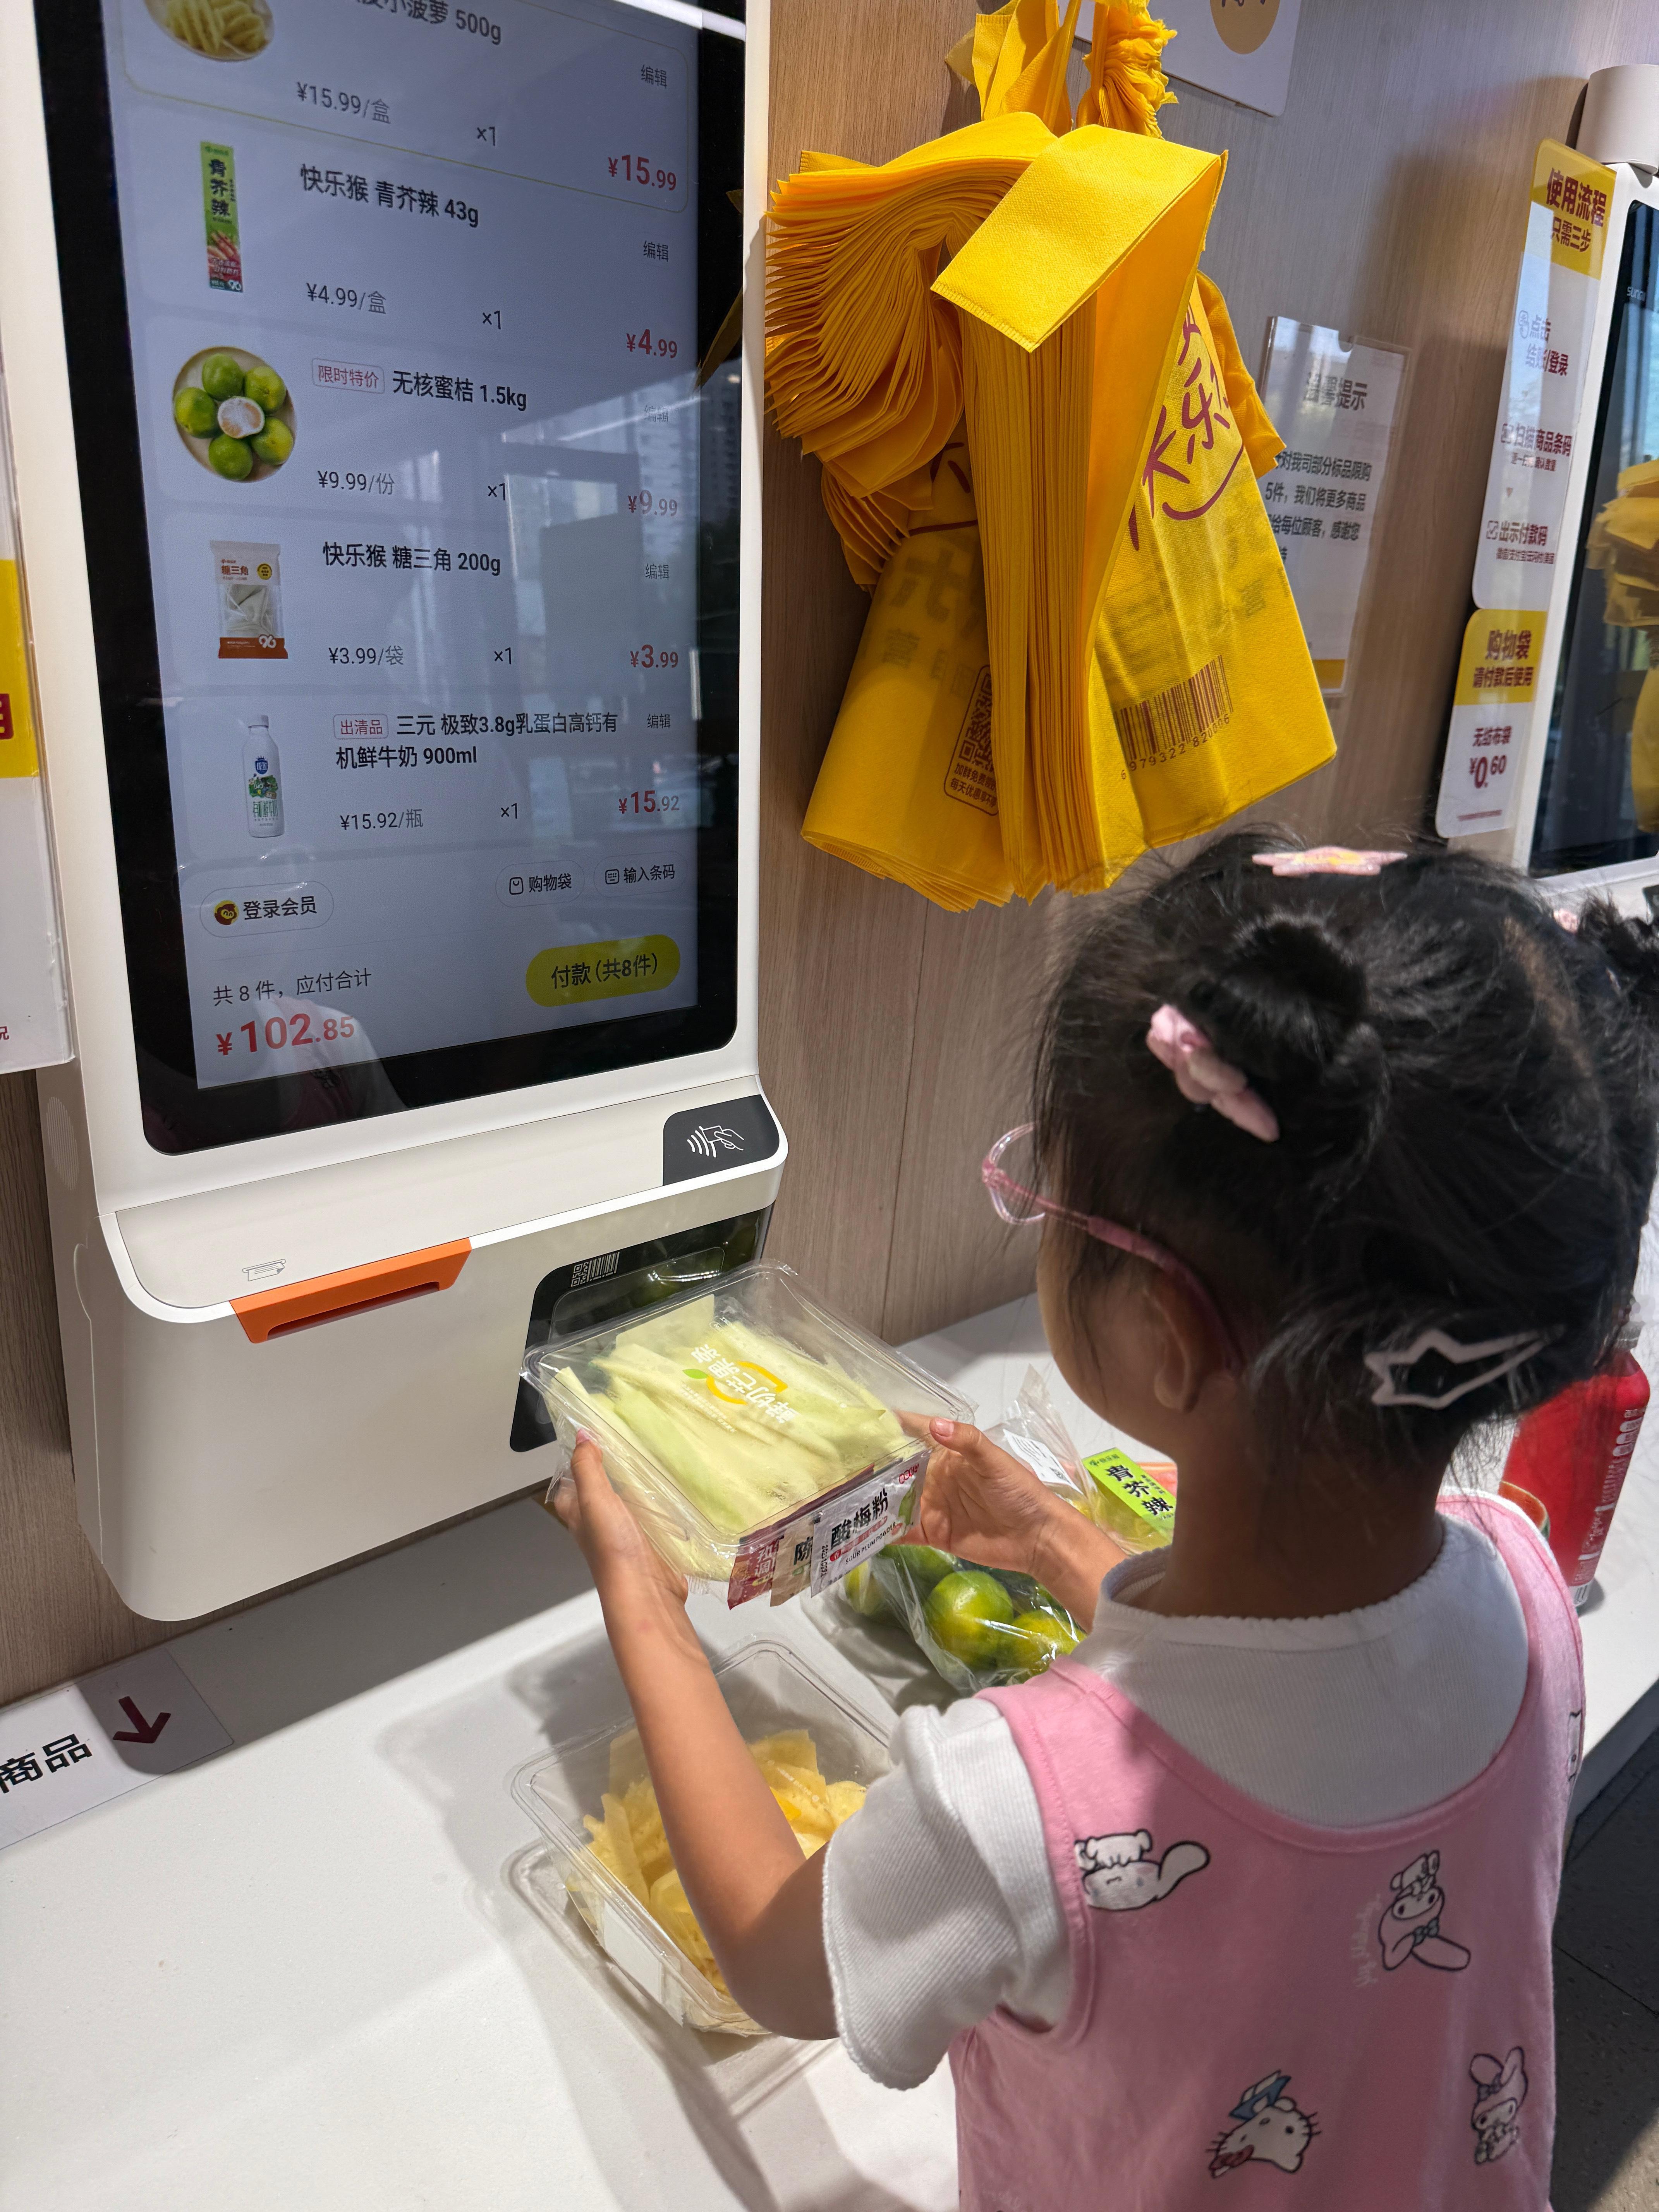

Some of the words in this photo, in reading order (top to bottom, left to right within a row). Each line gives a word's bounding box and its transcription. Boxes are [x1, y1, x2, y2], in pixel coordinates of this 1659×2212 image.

[456, 9, 501, 45] 500g
[641, 65, 667, 88] 编辑
[297, 82, 391, 124] ¥15.99/盒
[608, 155, 677, 191] ¥15.99
[301, 163, 369, 203] 快乐猴
[375, 181, 439, 217] 青芥辣
[445, 199, 479, 228] 43g
[1546, 167, 1607, 227] 使用流程
[1551, 216, 1591, 252] 只需三步
[643, 240, 669, 262] 编辑
[306, 282, 386, 314] ¥4.99/盒
[626, 328, 678, 359] ¥4.99
[317, 364, 379, 389] 限时特价
[392, 370, 473, 403] 无核蜜桔
[479, 384, 527, 411] 1.5kg
[644, 404, 669, 423] 编辑
[317, 470, 394, 495] ¥9.99/份
[628, 489, 678, 517] ¥9.99
[1499, 521, 1548, 546] 出示付款码
[323, 542, 388, 568] 快乐猴
[392, 546, 452, 572] 糖三角
[458, 553, 501, 576] 200g
[645, 563, 670, 580] 编辑
[329, 645, 404, 666] ¥3.99/袋
[630, 644, 678, 668] ¥3.99
[1485, 630, 1532, 660] 购物袋
[1473, 666, 1534, 689] 请付款后使用
[341, 719, 383, 736] 出清品
[396, 714, 436, 736] 三元
[441, 712, 618, 736] 极致3.8g乳蛋白高钙有
[647, 713, 671, 729] 编辑
[336, 746, 417, 770] 机鲜牛奶
[423, 746, 477, 766] 900ml
[618, 790, 680, 814] ¥15.92
[340, 808, 423, 831] ¥15.92/瓶
[528, 872, 572, 894] 购物袋
[623, 864, 675, 884] 输入条码
[242, 896, 318, 922] 登录会员
[690, 1343, 802, 1424] 鲜切芒果条
[1105, 1465, 1173, 1515] 青芥辣
[831, 1487, 888, 1550] 酸梅粉
[846, 1551, 860, 1564] SOUR
[861, 1539, 875, 1553] PLUM
[876, 1522, 896, 1542] POWDER
[0, 1734, 92, 1794] 商品
